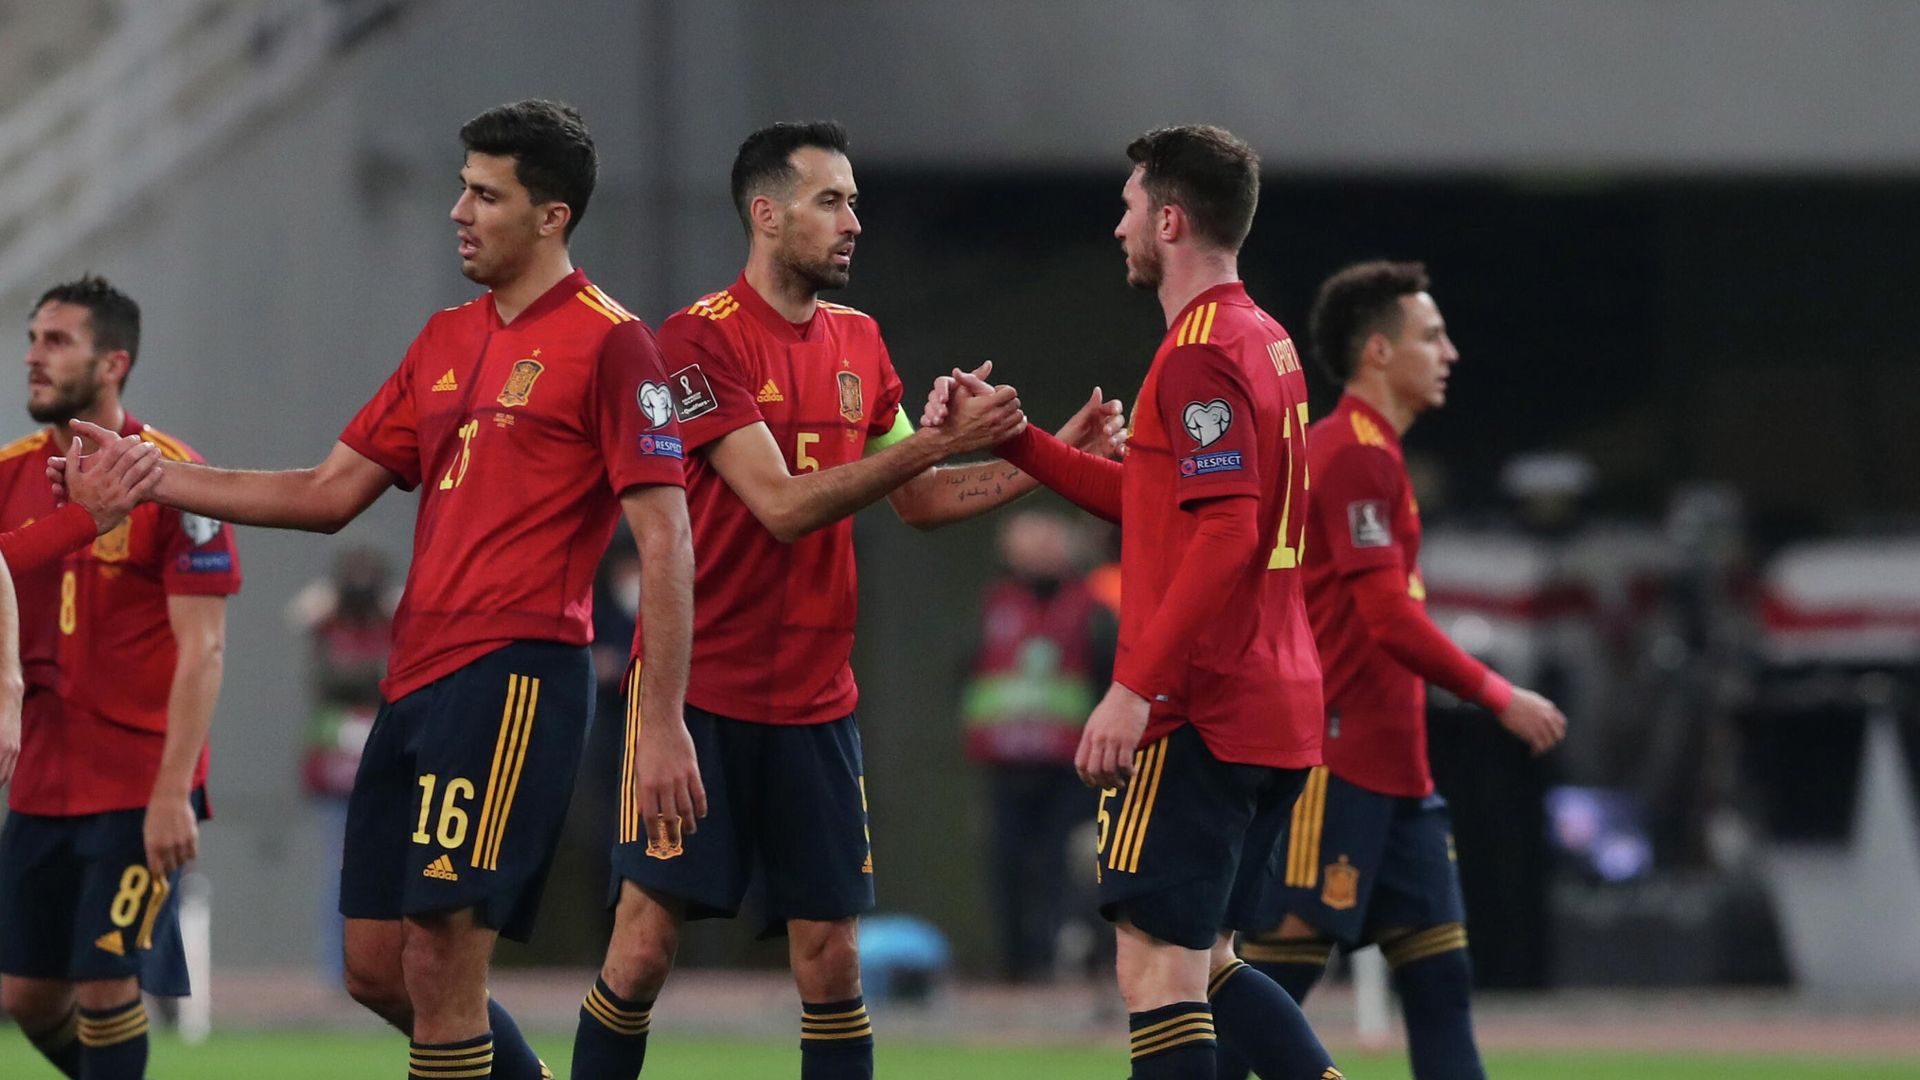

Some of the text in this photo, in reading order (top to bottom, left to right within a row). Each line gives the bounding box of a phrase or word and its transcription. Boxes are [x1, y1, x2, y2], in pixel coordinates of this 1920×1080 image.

[756, 392, 784, 403] adidas
[796, 432, 820, 472] 5
[1196, 455, 1242, 469] RESPECT
[60, 570, 76, 635] 8
[412, 773, 475, 849] 16
[423, 868, 459, 881] adidas
[110, 864, 150, 927] 8
